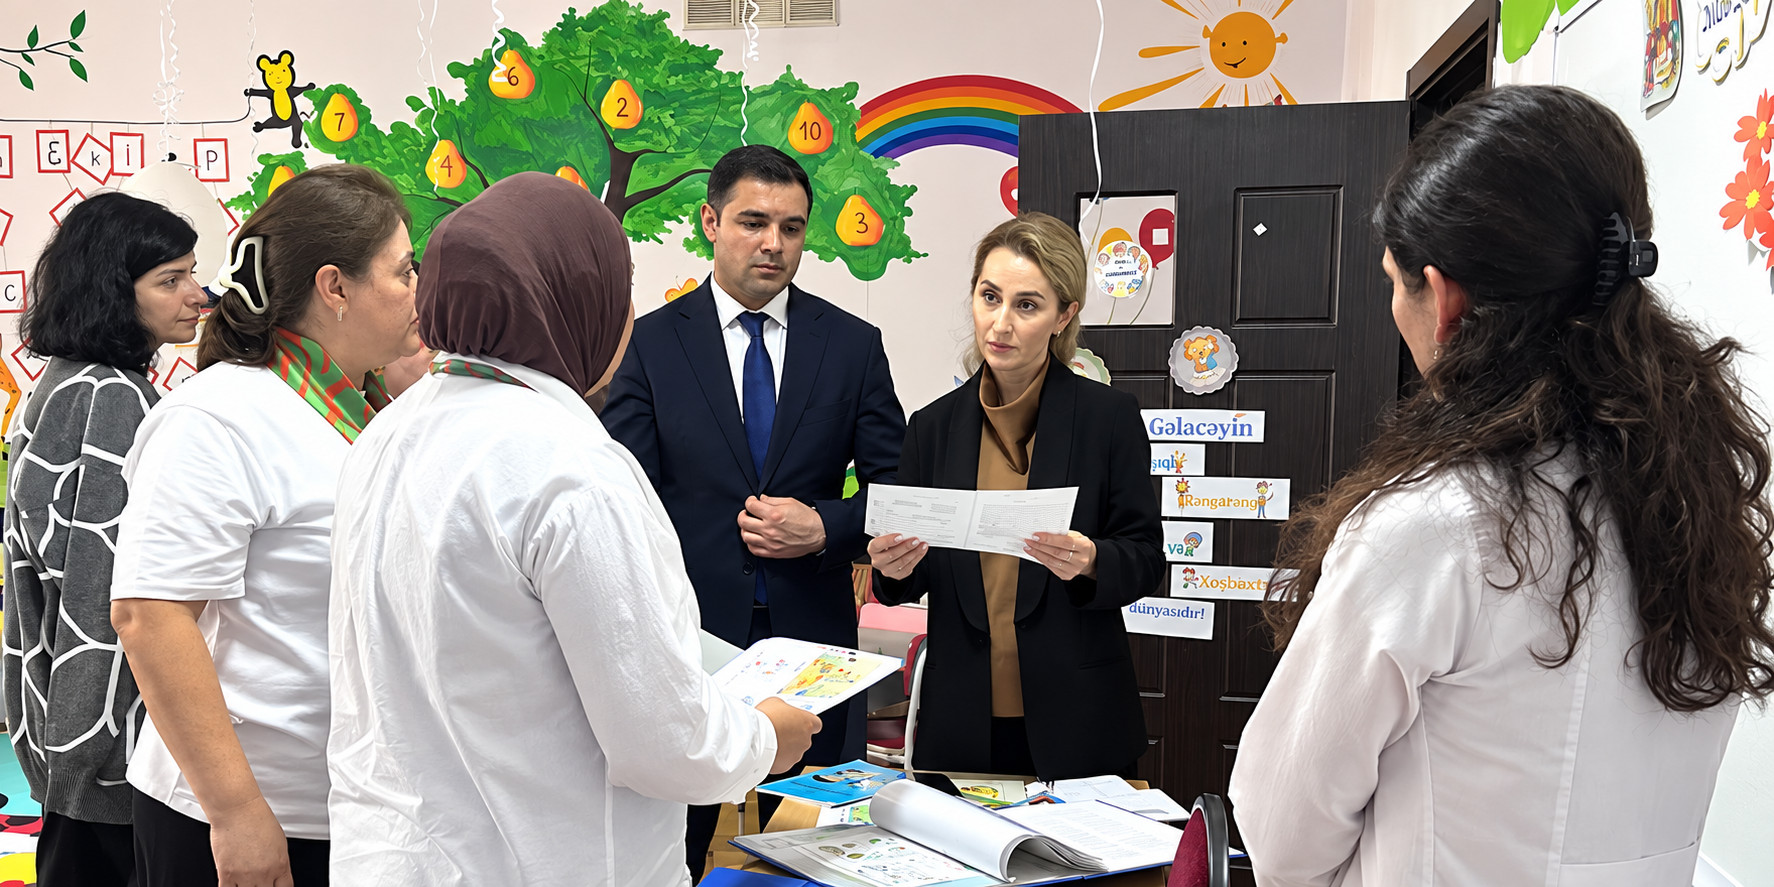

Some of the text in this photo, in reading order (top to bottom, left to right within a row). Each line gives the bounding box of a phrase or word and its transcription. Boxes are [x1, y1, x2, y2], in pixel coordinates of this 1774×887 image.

[507, 67, 519, 86] 6
[616, 97, 629, 118] 2
[334, 112, 345, 131] 7
[799, 121, 822, 141] 10
[440, 155, 453, 178] 4
[855, 212, 869, 234] 3
[1185, 494, 1258, 511] Rəngarəng
[1167, 543, 1184, 555] və
[1129, 602, 1205, 620] dünyasıdır!
